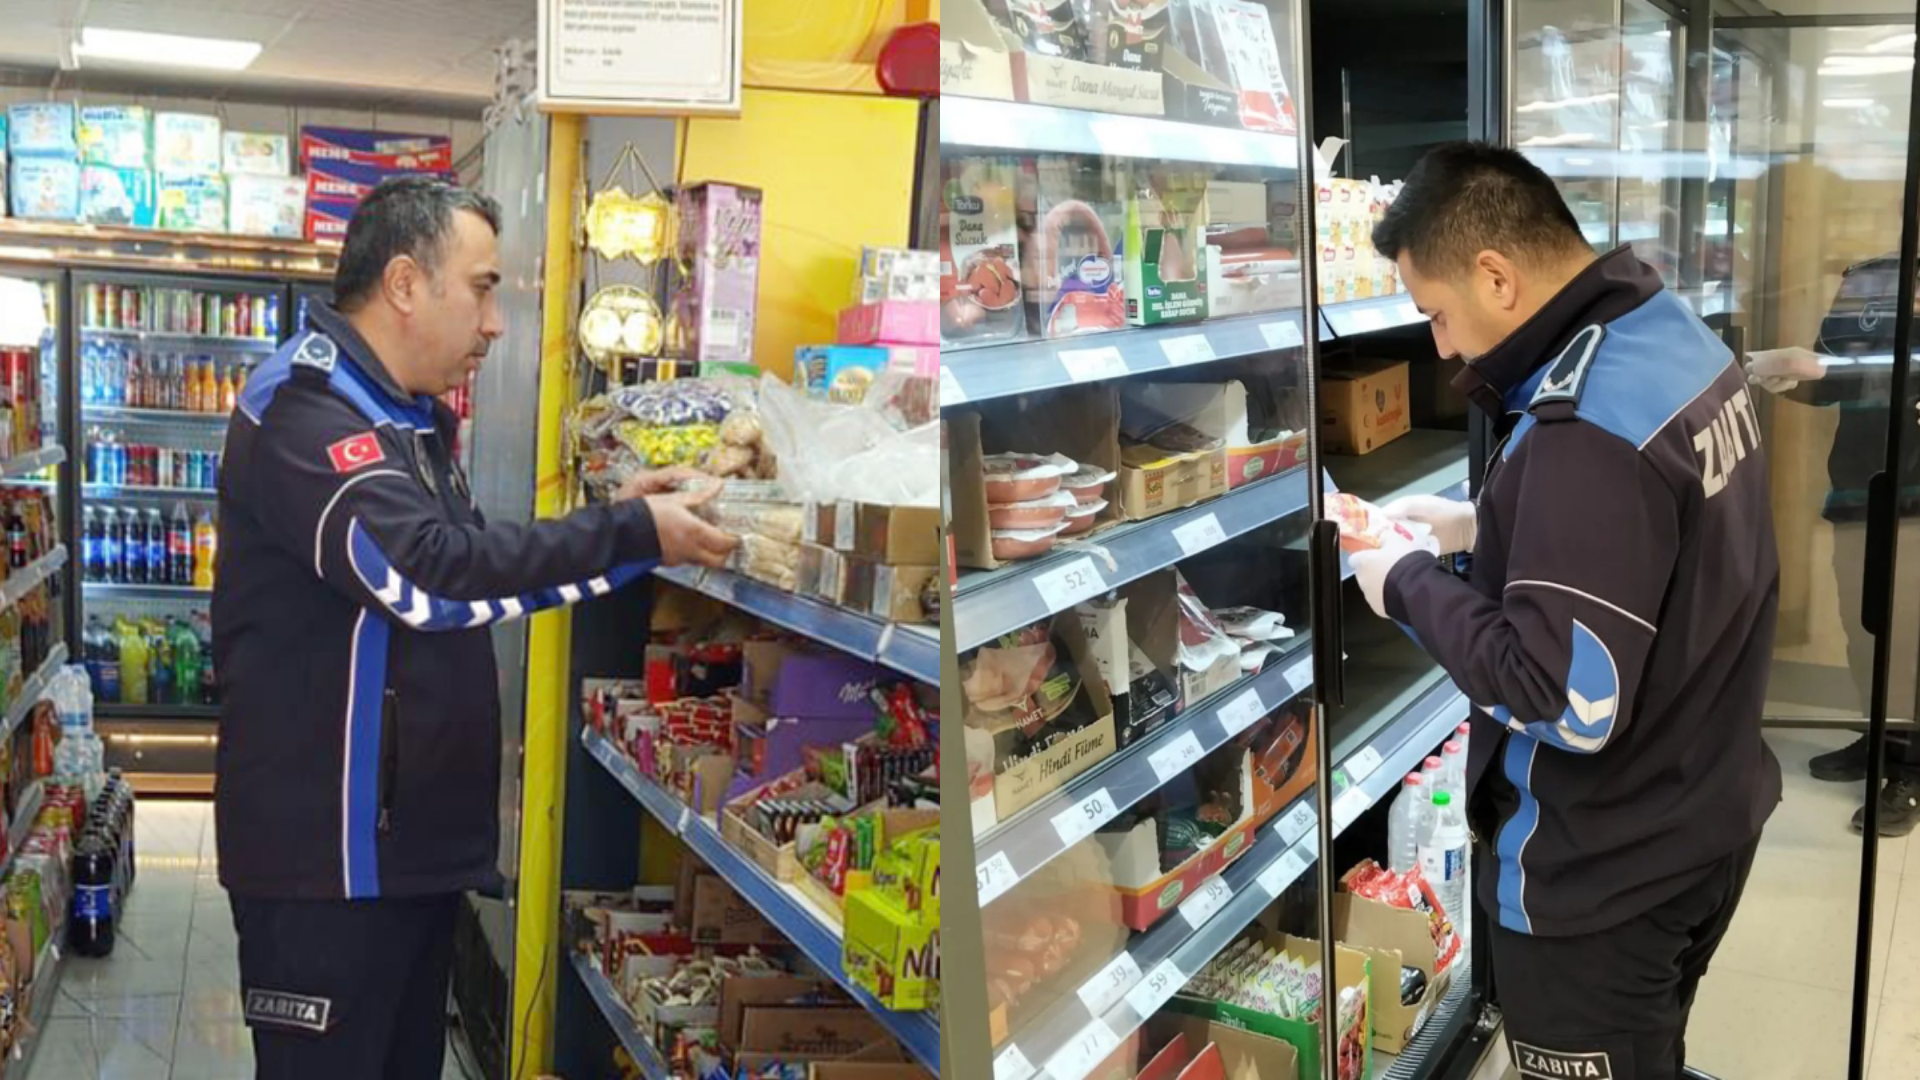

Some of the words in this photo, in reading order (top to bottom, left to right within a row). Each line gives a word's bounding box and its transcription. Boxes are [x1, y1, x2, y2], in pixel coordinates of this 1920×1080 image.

[1123, 48, 1142, 63] Dana
[1072, 75, 1099, 96] Dana
[1100, 80, 1137, 102] Mangal
[315, 220, 348, 233] MEM
[960, 219, 983, 232] Dana
[955, 232, 988, 246] Sucuk
[1693, 382, 1762, 499] ZABIT
[1064, 570, 1086, 590] 52
[1015, 707, 1045, 730] NAMET
[1039, 747, 1072, 783] Hindi
[1074, 733, 1105, 761] Füme
[1082, 798, 1103, 820] 50
[1206, 883, 1224, 901] 95
[1110, 965, 1127, 988] 39
[1148, 972, 1168, 993] 59
[252, 995, 317, 1021] ZABITA
[1523, 1050, 1600, 1078] ZABITA
